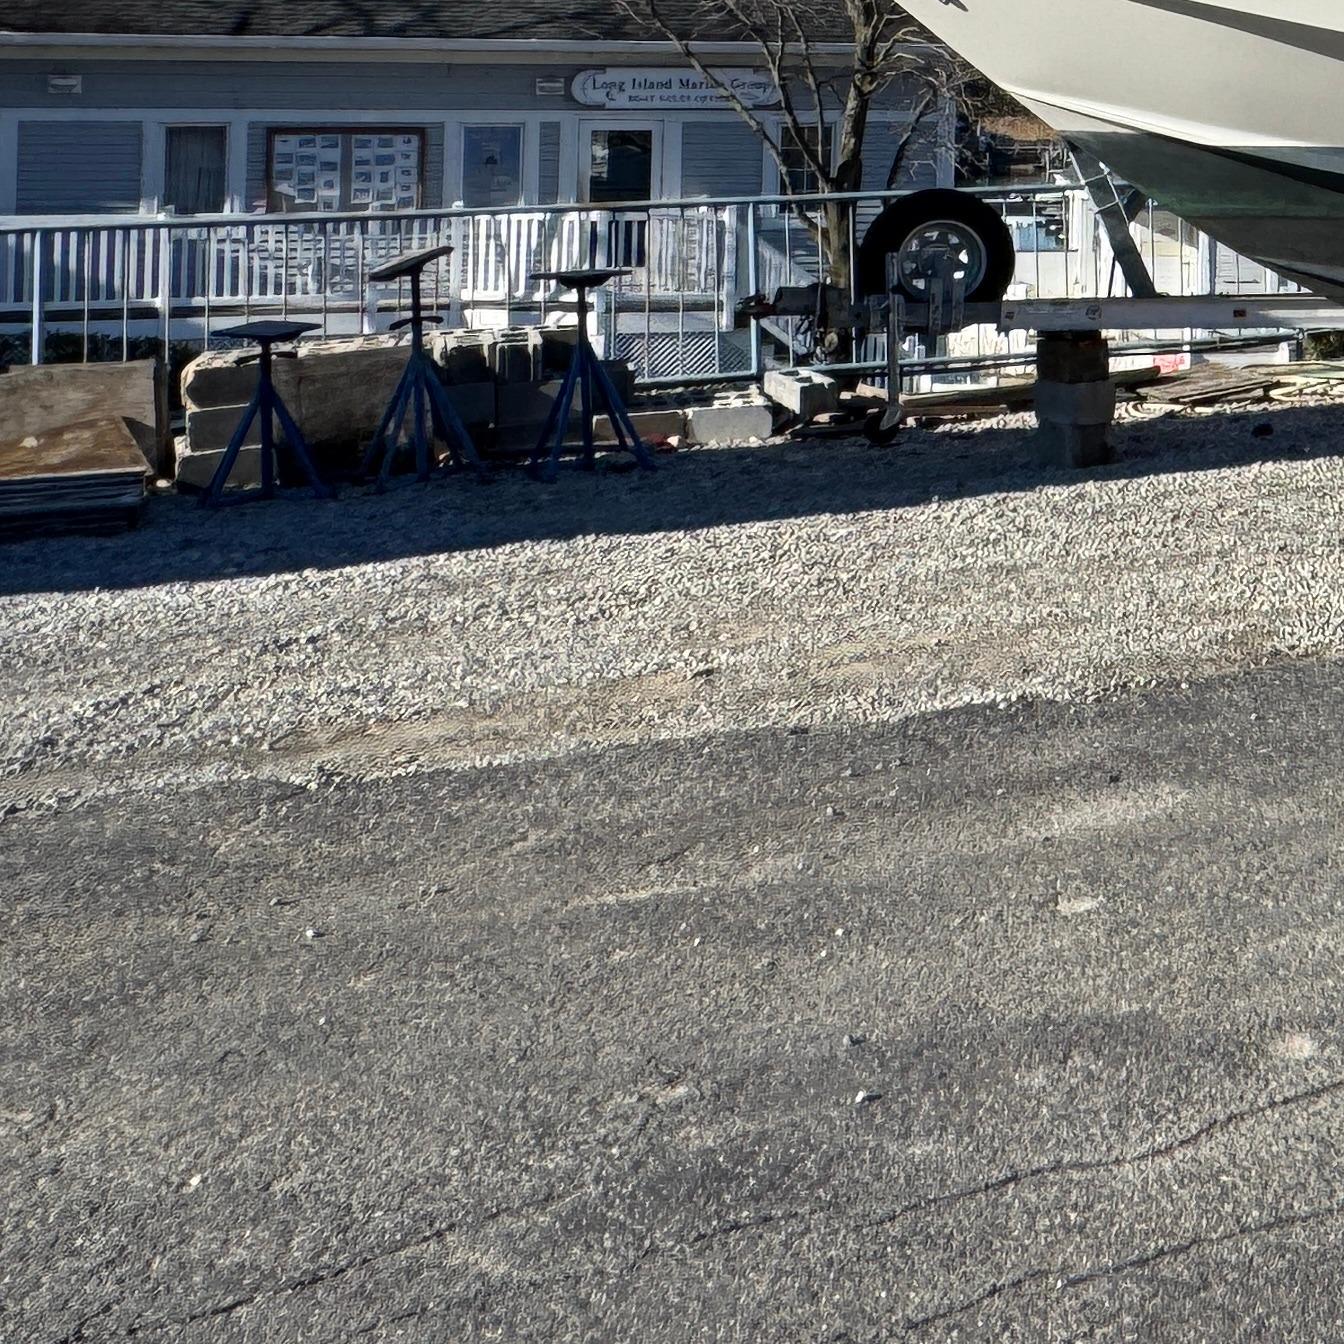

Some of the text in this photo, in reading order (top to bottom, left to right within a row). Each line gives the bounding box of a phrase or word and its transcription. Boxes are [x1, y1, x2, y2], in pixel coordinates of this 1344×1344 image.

[592, 76, 626, 93] Long
[632, 77, 673, 91] Island
[679, 77, 725, 91] Mari
